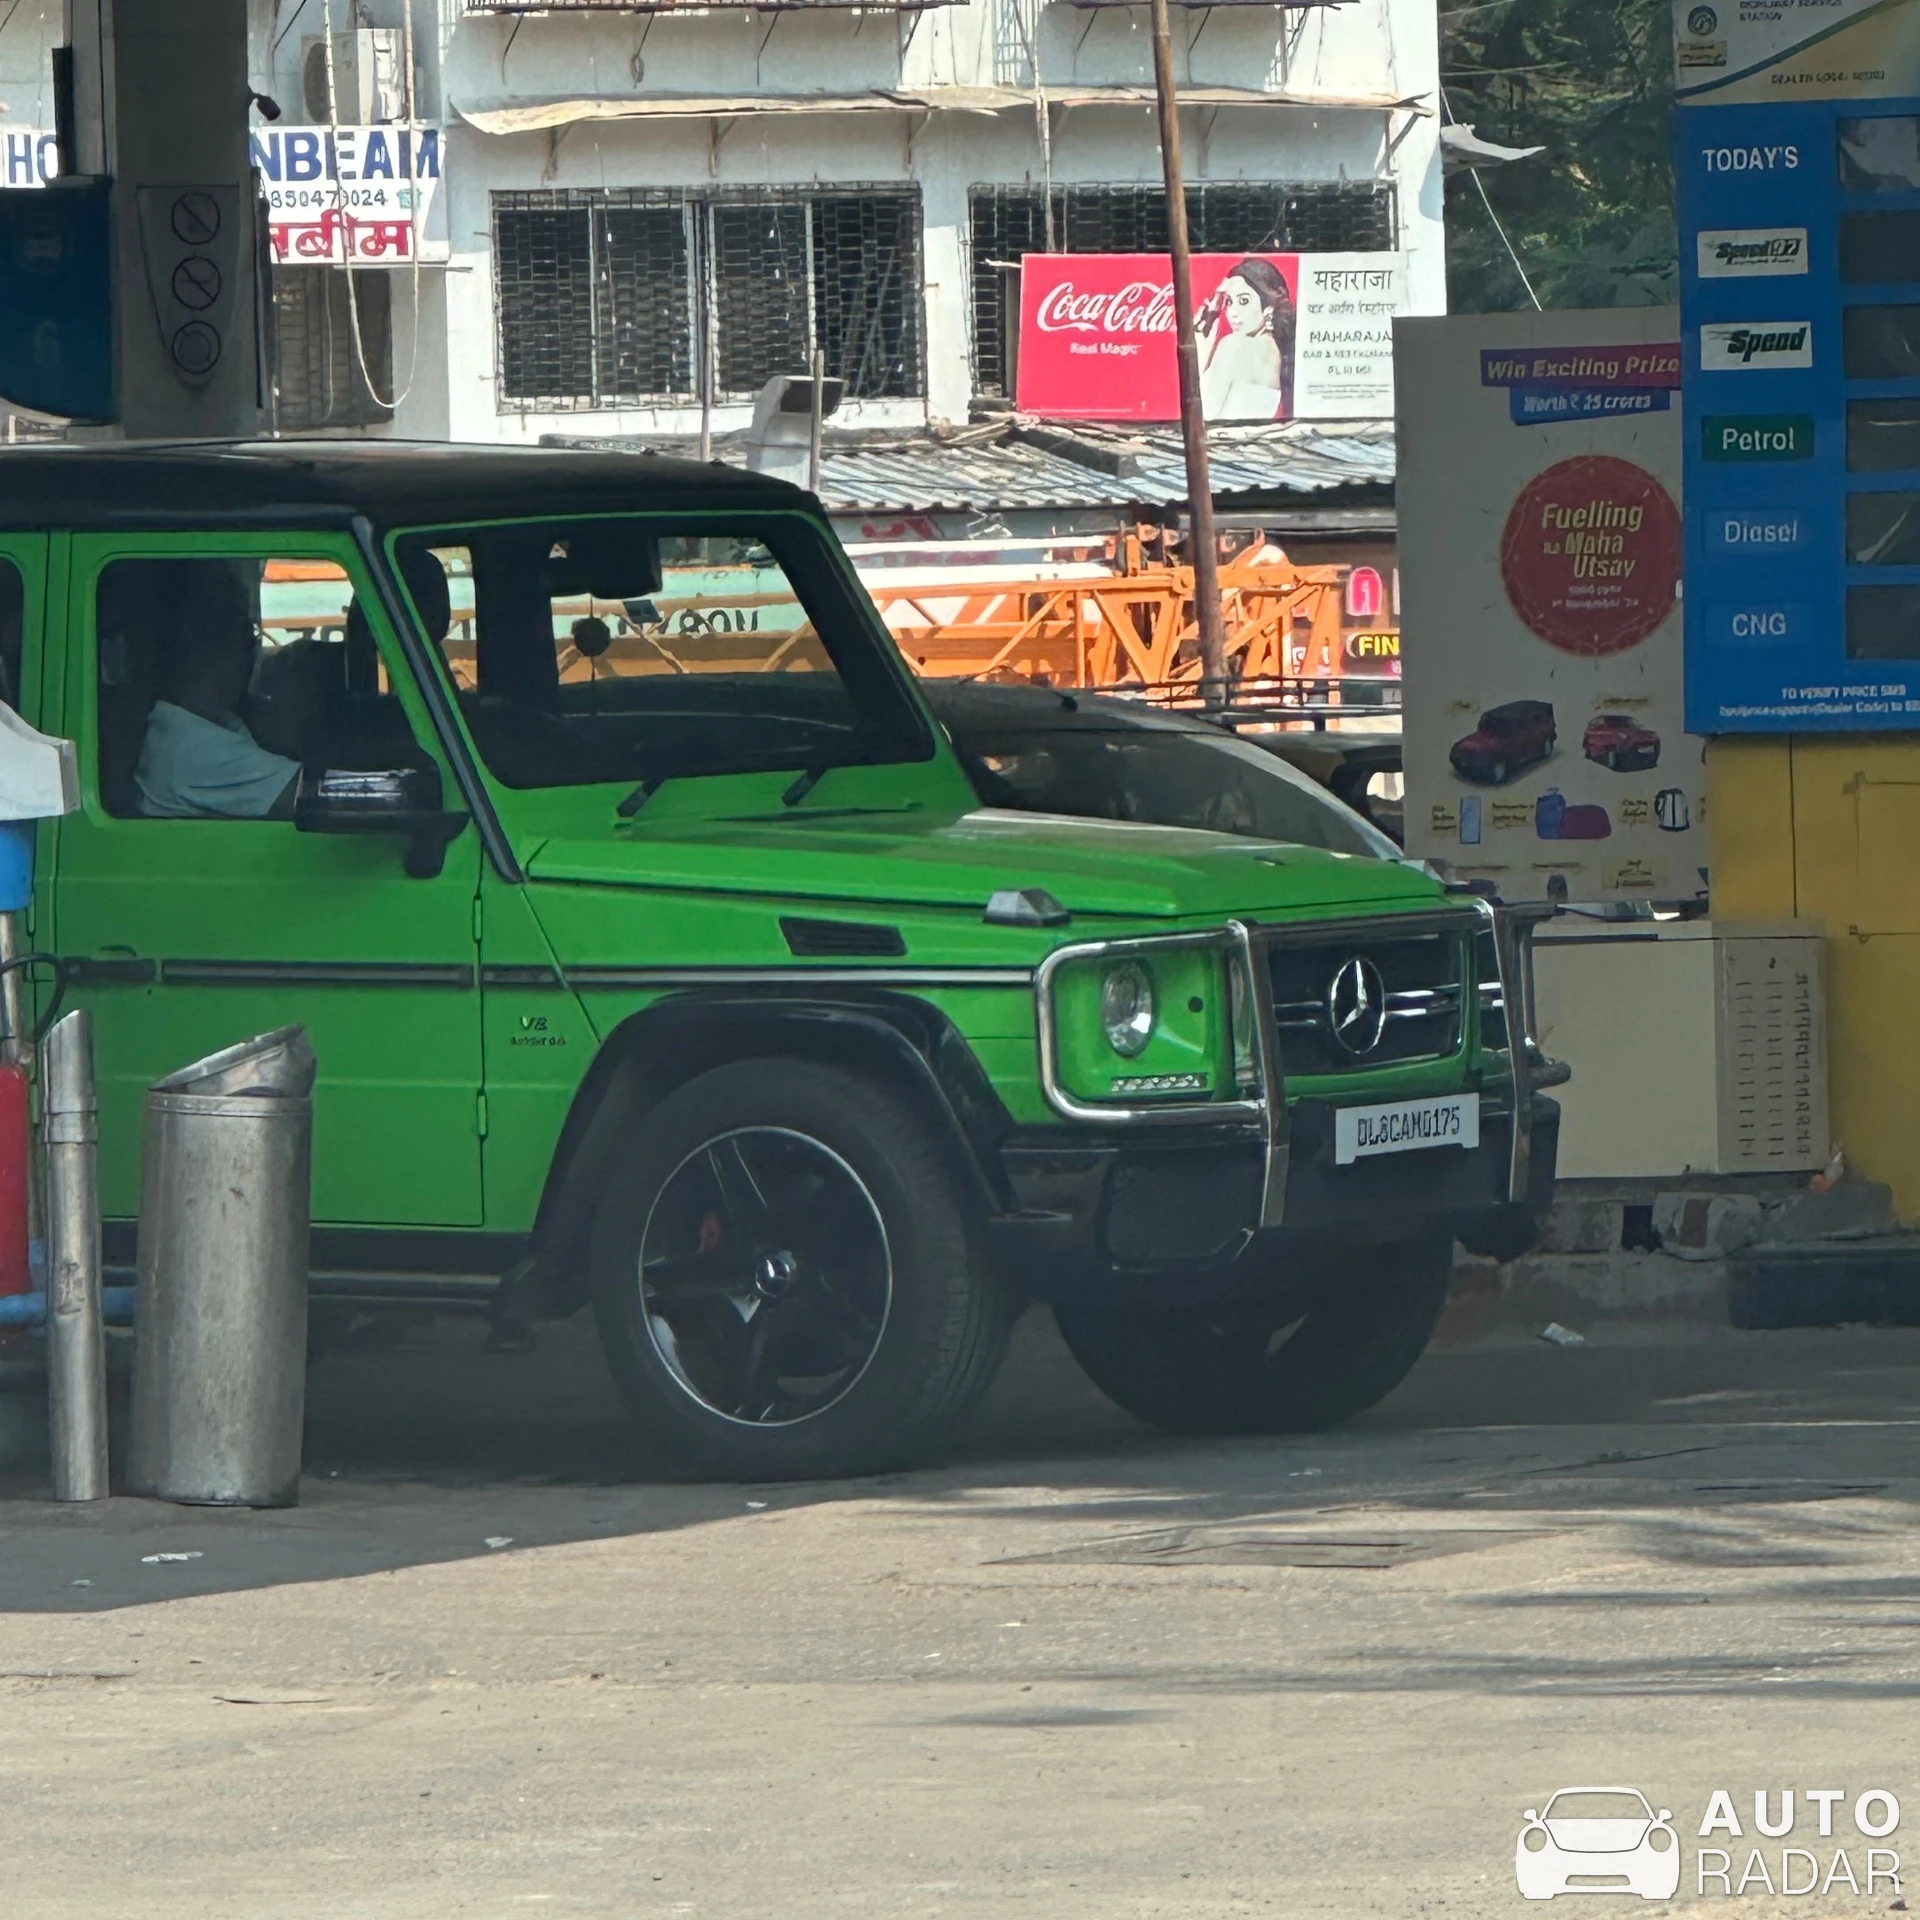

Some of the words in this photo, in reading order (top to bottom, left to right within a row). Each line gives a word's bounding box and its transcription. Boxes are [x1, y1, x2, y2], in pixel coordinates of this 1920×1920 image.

[1702, 146, 1799, 172] TODAY'S
[1313, 270, 1394, 293] महाराजा
[1309, 331, 1393, 344] MAHARAJA
[1727, 326, 1808, 363] Speed
[1487, 360, 1526, 379] Win
[1532, 357, 1619, 379] Exciting
[1722, 427, 1795, 451] Petrol
[1541, 500, 1644, 533] Fuelling
[1564, 530, 1624, 555] Maha
[1724, 520, 1798, 543] Diesel
[1732, 612, 1787, 637] CNG
[1358, 636, 1400, 656] FIN
[1782, 687, 1797, 700] TO
